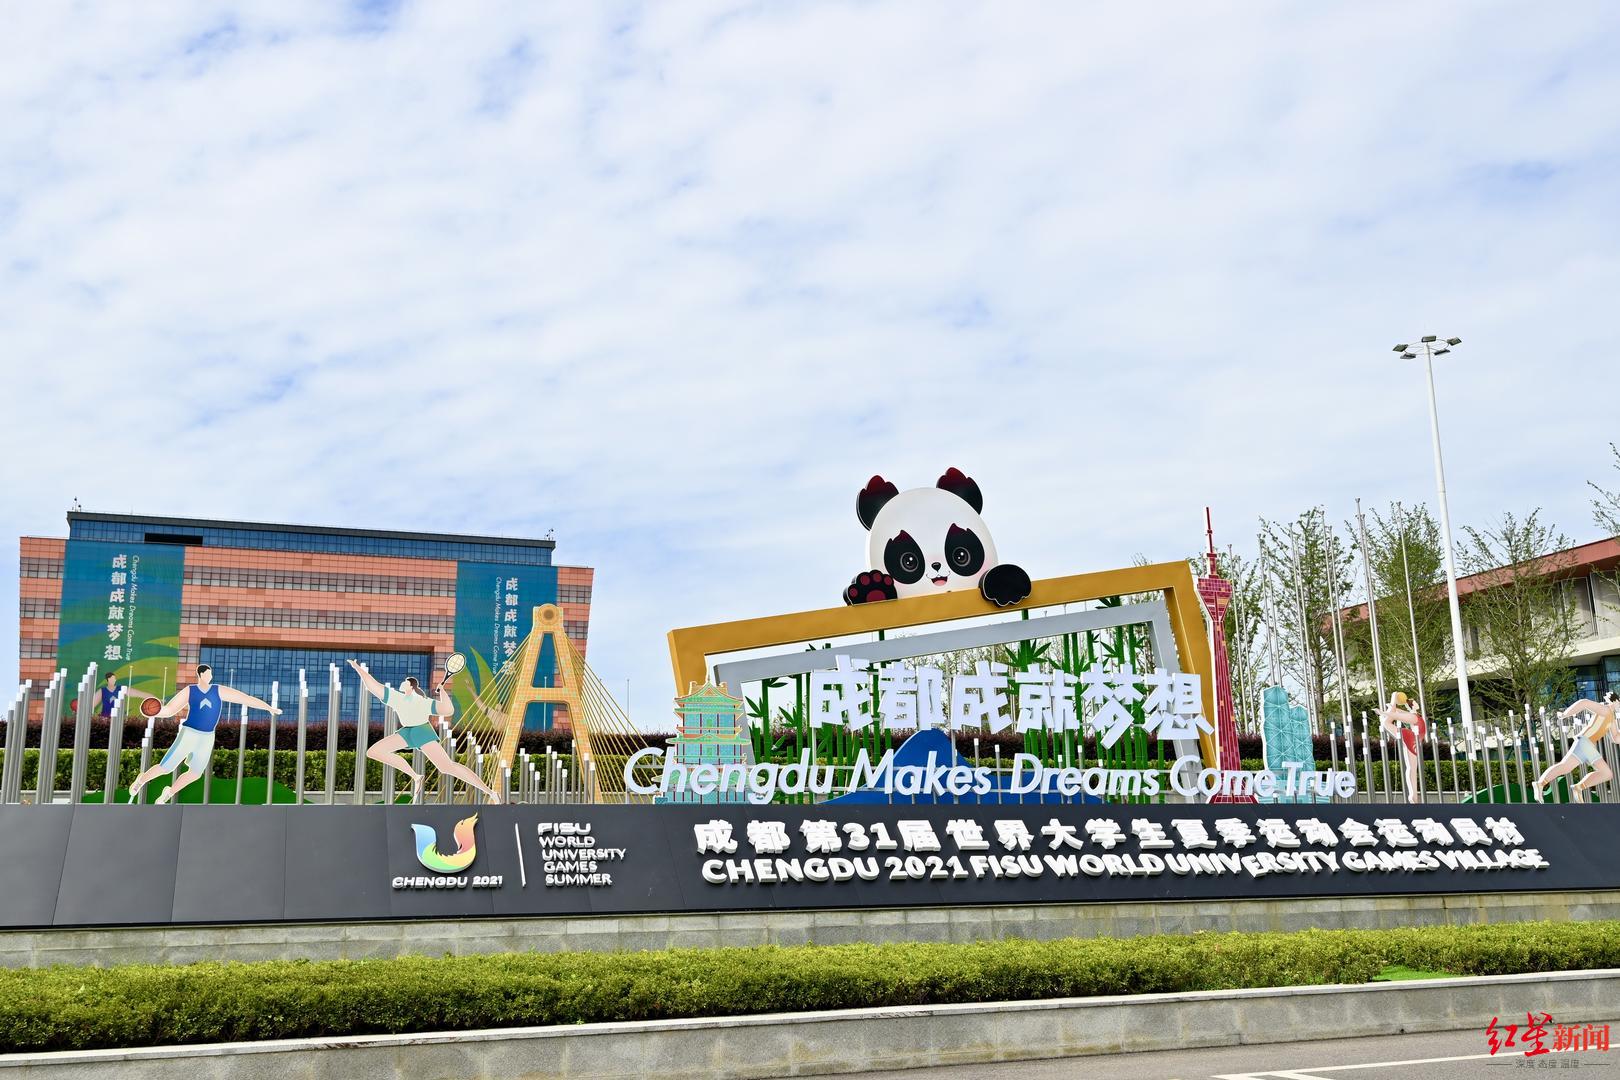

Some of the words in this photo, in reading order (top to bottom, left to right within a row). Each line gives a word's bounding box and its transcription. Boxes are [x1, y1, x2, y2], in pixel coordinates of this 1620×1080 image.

[130, 555, 139, 583] Chengdu
[129, 583, 138, 604] Makes
[494, 577, 502, 601] Chengdu
[104, 554, 127, 661] 成都成就梦想
[128, 605, 136, 629] Dreams
[127, 629, 135, 647] Come
[809, 654, 1214, 750] 成都成就梦想
[624, 747, 836, 805] Chengdu
[849, 748, 992, 797] Makes
[1010, 753, 1161, 797] Dreams
[1170, 755, 1277, 798] Come
[1281, 761, 1356, 799] True
[538, 822, 592, 835] FISU
[694, 816, 1525, 855] 成都第31届世界大学生夏季运动会运动员村
[539, 836, 596, 848] WORLD
[542, 848, 627, 861] UNIVERSITY
[543, 861, 598, 873] GAMES
[702, 856, 880, 884] CHENGDU
[884, 855, 969, 882] 2021
[968, 854, 1044, 880] FISU
[1044, 852, 1165, 879] WORLD
[1165, 850, 1342, 878] UNIVERSITY
[1341, 849, 1441, 873] GAMES
[1434, 849, 1550, 872] VILLAGE
[392, 876, 468, 889] CHENGDU
[473, 875, 504, 889] 2021
[545, 873, 613, 886] SUMMER
